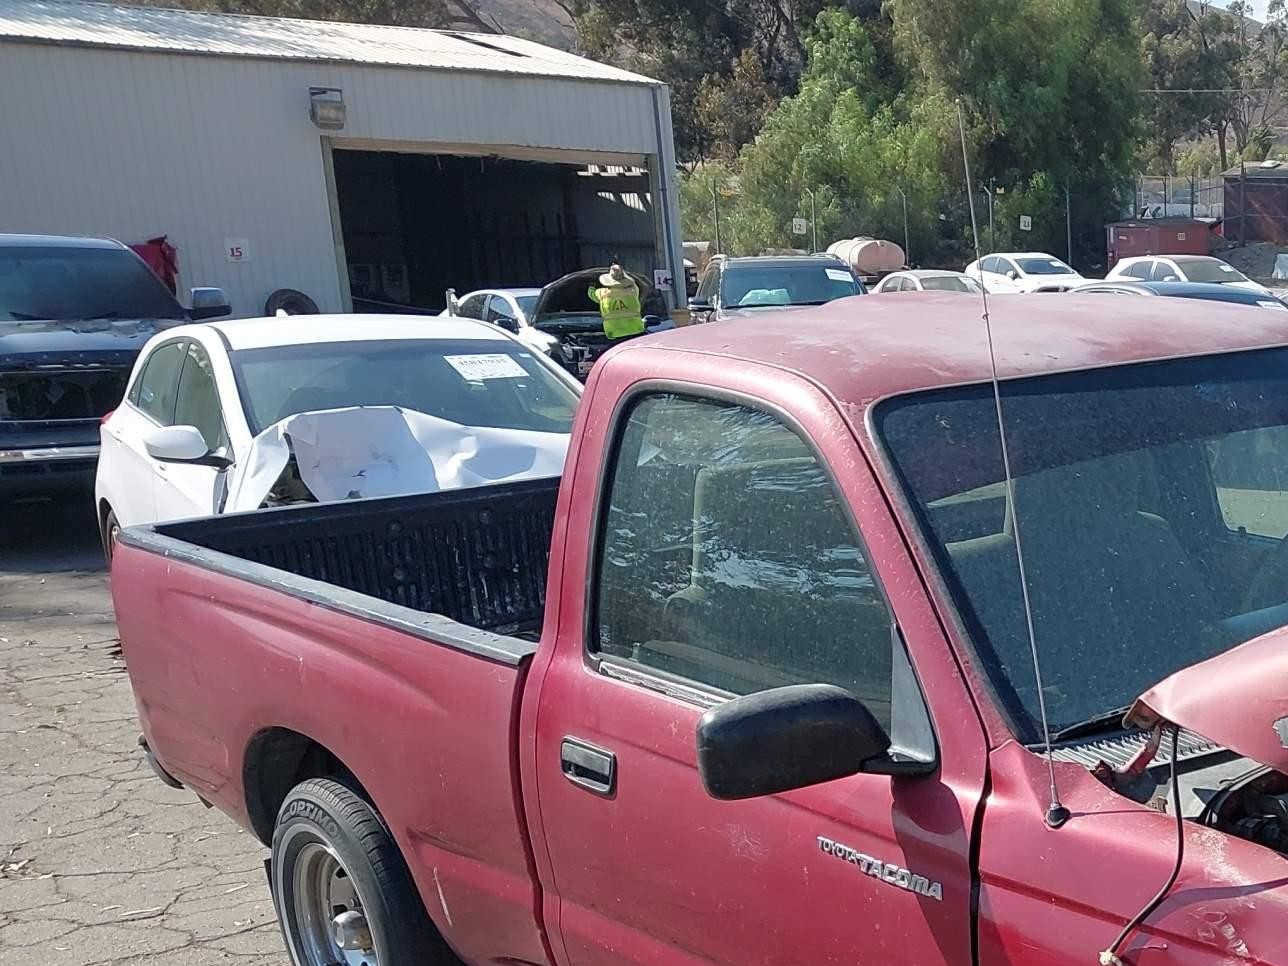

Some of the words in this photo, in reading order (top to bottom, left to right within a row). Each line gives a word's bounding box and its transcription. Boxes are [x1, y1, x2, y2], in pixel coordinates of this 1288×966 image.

[230, 247, 243, 257] 15
[289, 800, 338, 838] OPTIMO
[817, 836, 857, 863] TOYOTA
[856, 853, 943, 901] TACOMA
